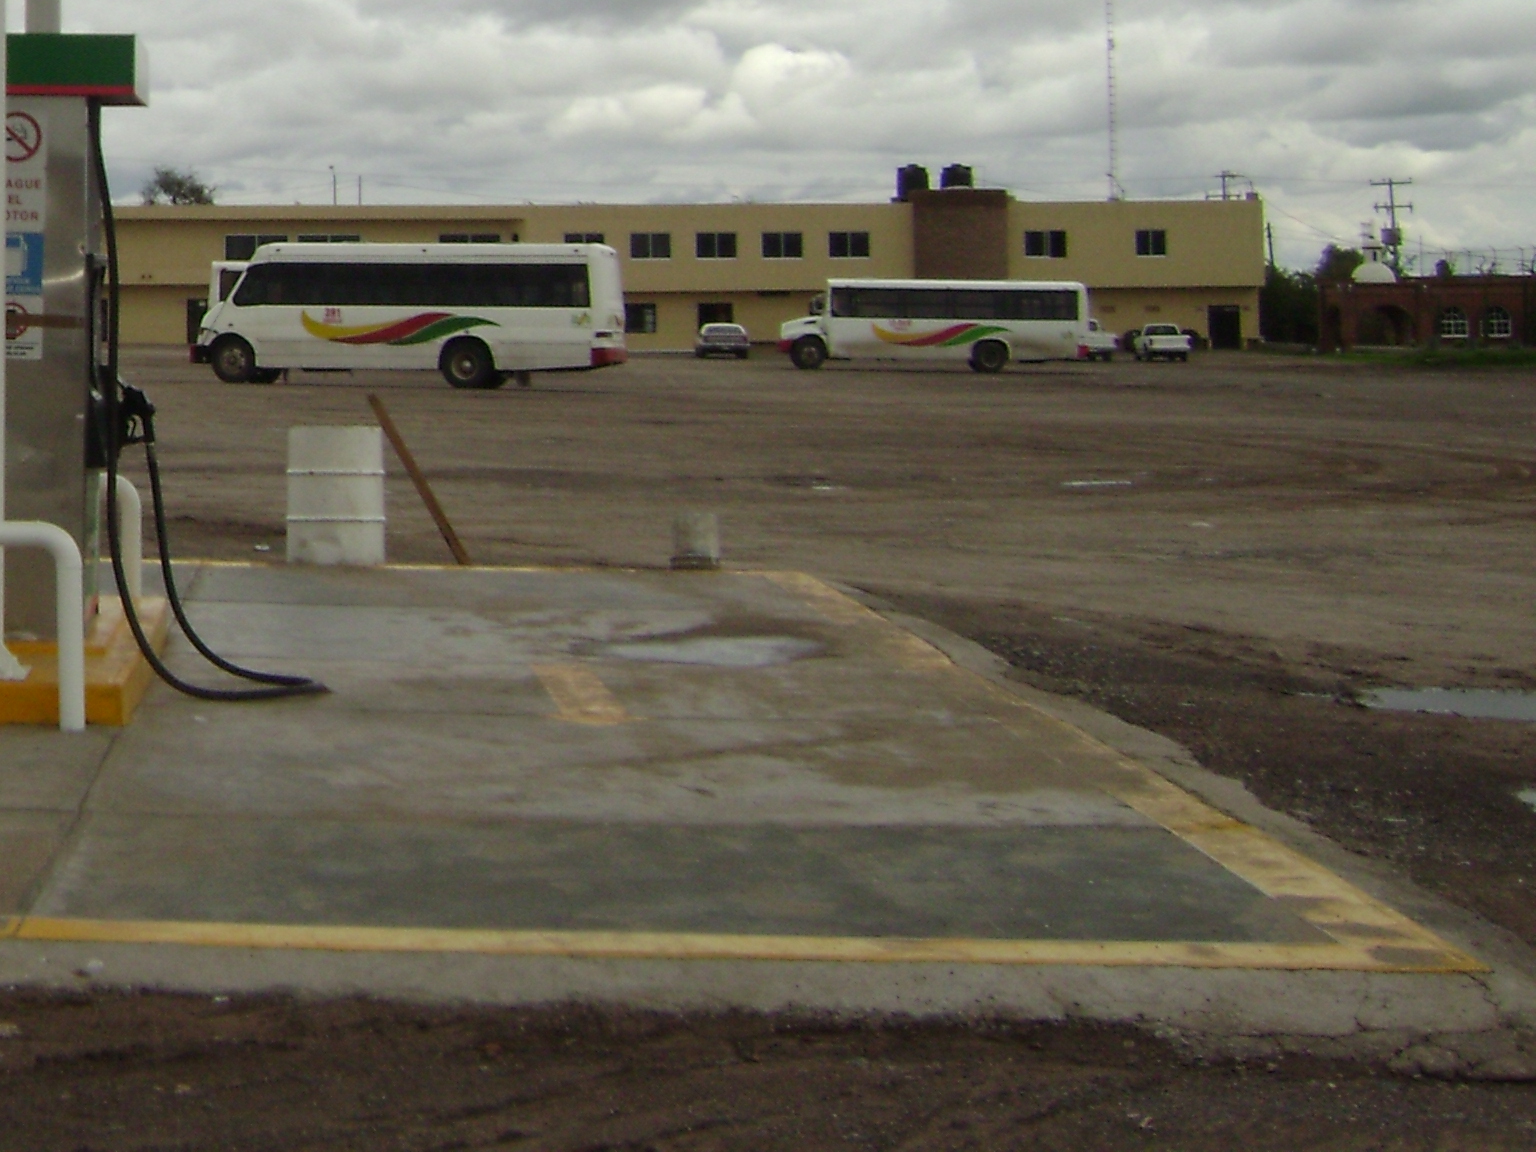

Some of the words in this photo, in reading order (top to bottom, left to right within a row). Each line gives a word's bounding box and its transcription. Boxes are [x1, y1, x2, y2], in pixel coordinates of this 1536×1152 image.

[5, 178, 41, 189] AGUE
[7, 194, 23, 205] EL
[5, 209, 39, 221] OTOR
